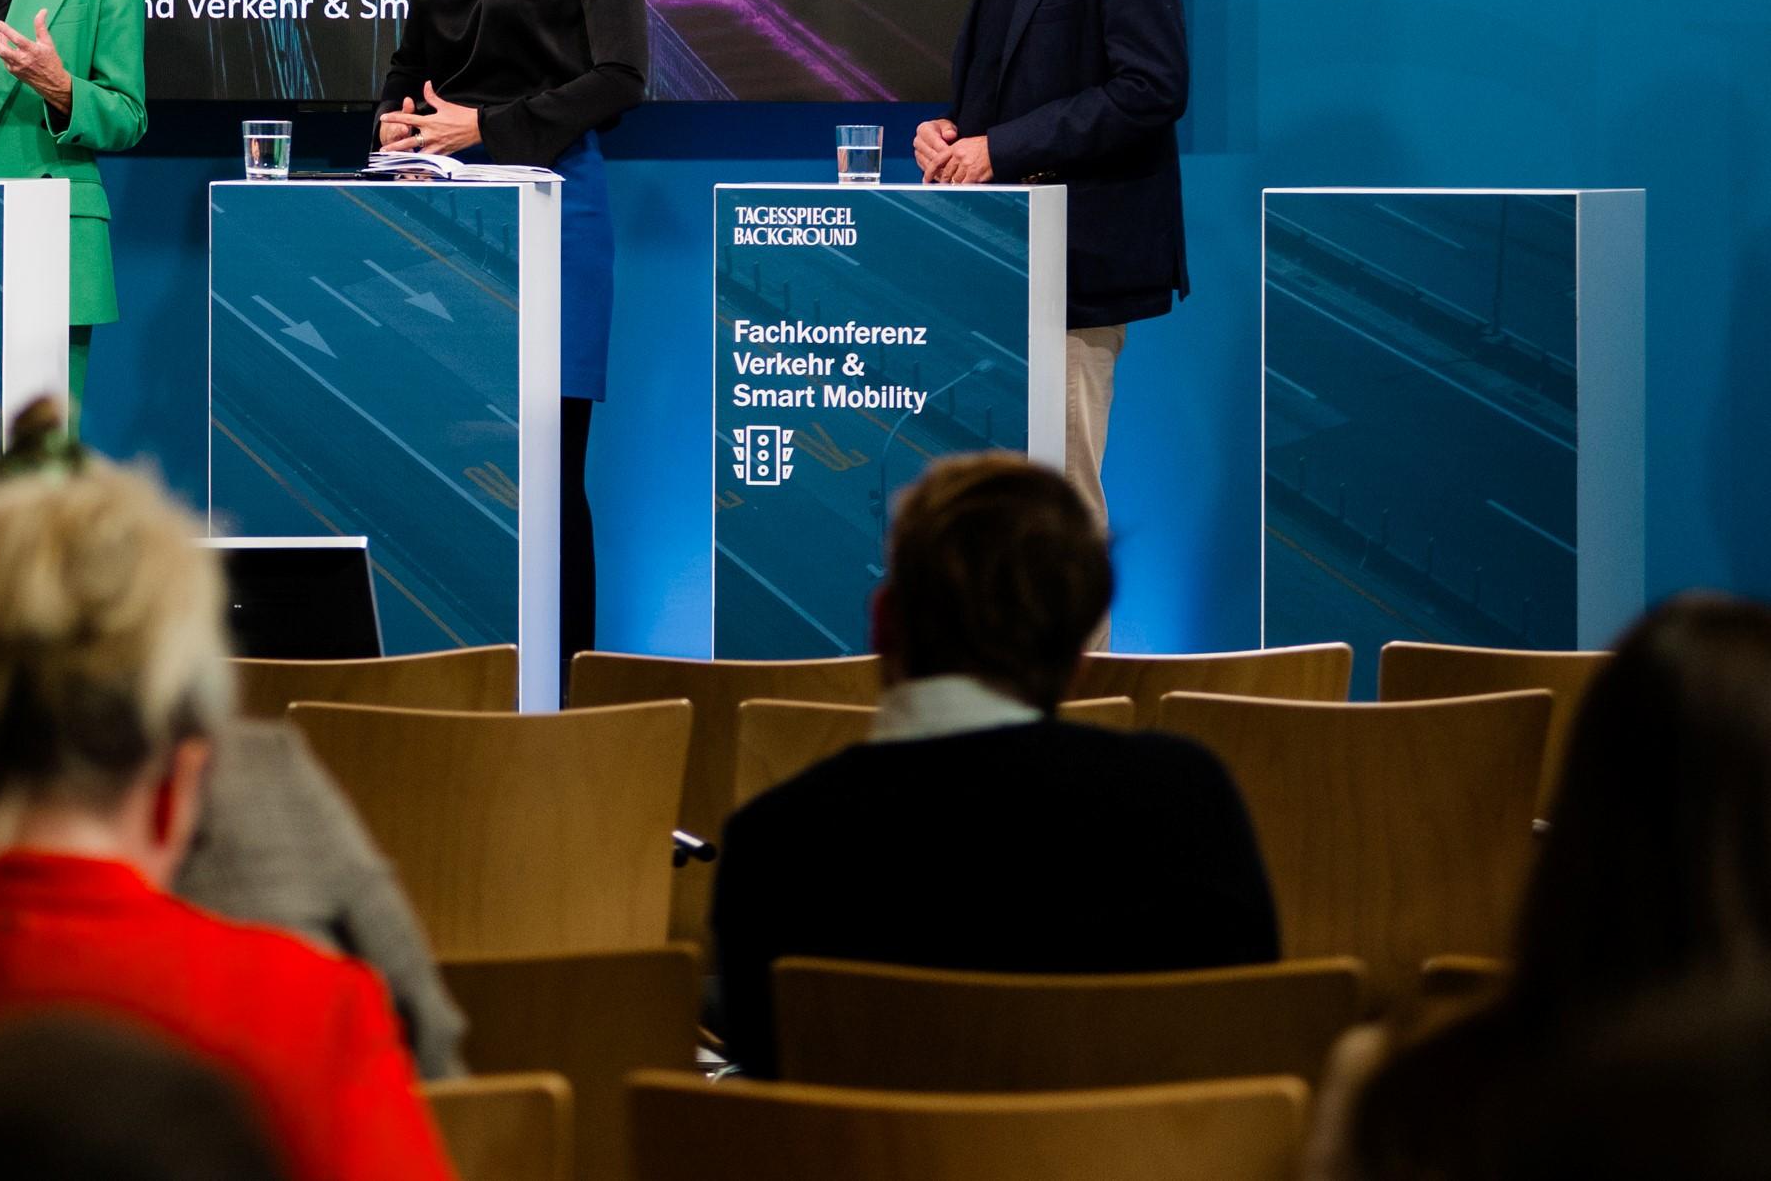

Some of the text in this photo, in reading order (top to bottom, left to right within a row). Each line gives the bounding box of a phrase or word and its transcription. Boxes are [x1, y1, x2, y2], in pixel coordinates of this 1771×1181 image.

[735, 206, 856, 226] TAGESSPIEGEL
[733, 226, 857, 246] BACKGROUND
[734, 319, 927, 345] Fachkonferenz
[733, 351, 865, 377] Verkehr &
[732, 383, 928, 414] Smart Mobility
